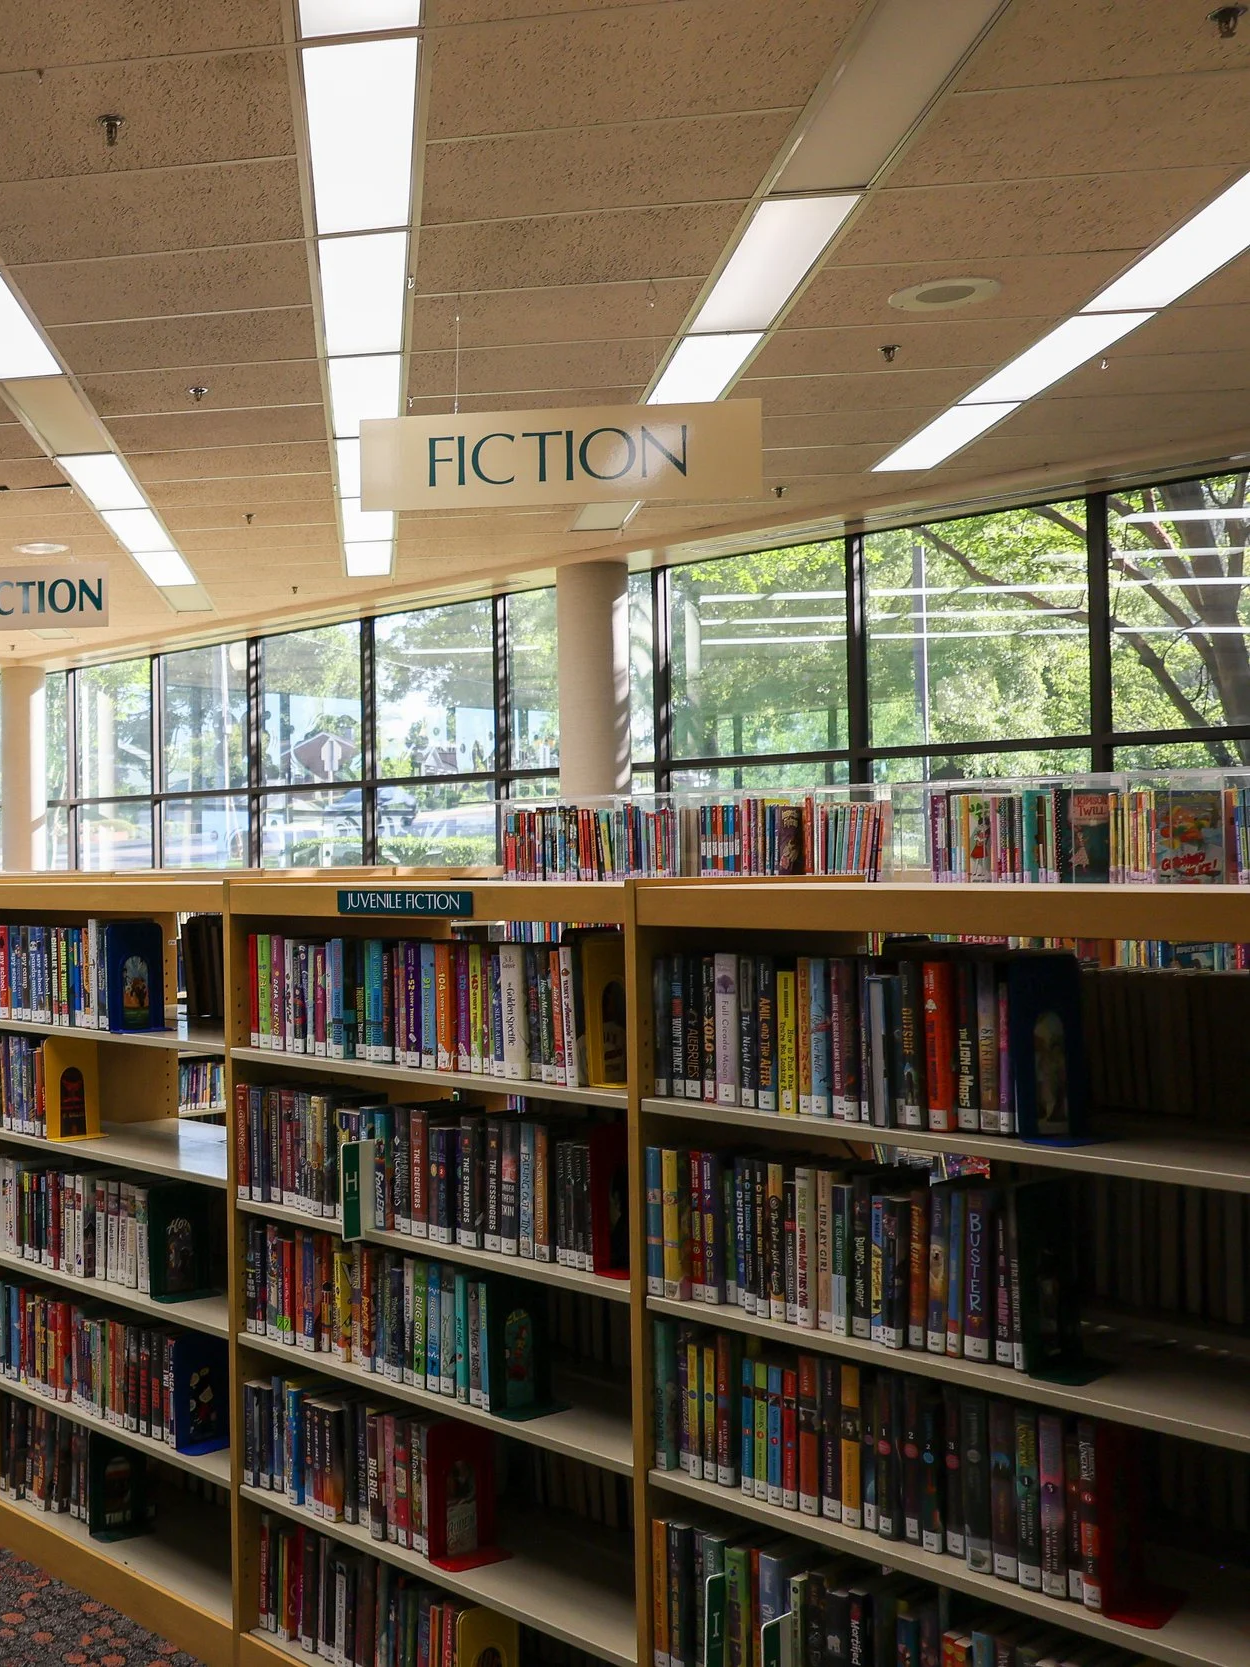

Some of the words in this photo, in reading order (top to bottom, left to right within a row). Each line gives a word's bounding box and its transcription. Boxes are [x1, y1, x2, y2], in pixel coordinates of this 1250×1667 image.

[428, 425, 687, 487] FICTION
[347, 893, 402, 910] JUVENILE
[405, 893, 460, 910] FICTION
[506, 988, 514, 1015] Golden
[722, 1000, 730, 1015] Full
[760, 997, 771, 1021] AMIL
[494, 1007, 502, 1031] SILVER
[506, 1017, 516, 1046] Specific
[672, 1018, 682, 1044] WON'T
[742, 1015, 751, 1030] The
[494, 1032, 502, 1056] ARROW
[704, 1016, 715, 1052] XOLO
[722, 1019, 730, 1050] Cicada
[814, 1037, 823, 1052] Over
[672, 1046, 682, 1073] DANCE
[687, 1028, 699, 1077] ALEBRIJES
[742, 1036, 751, 1062] Night
[959, 1041, 972, 1065] LION
[981, 1029, 995, 1092] SKYRIDERS
[722, 1054, 730, 1079] Moon
[761, 1058, 772, 1086] AFTER
[814, 1053, 823, 1073] Water
[742, 1066, 751, 1089] Diar
[959, 1075, 974, 1108] MARS
[489, 1159, 497, 1175] THE
[521, 1153, 530, 1189] FALLING
[346, 1171, 357, 1192] H
[375, 1171, 385, 1211] FOOLED
[489, 1177, 497, 1230] MESSENGERS
[521, 1191, 530, 1209] OUT
[521, 1217, 530, 1240] TIME
[835, 1214, 844, 1228] PINE
[835, 1228, 844, 1249] ISLAND
[855, 1236, 865, 1265] BUMPS
[835, 1249, 844, 1275] VISITORS
[969, 1213, 983, 1312] BUSTER
[799, 1272, 808, 1289] THIS
[799, 1291, 809, 1308] ONE
[855, 1279, 864, 1308] NIGHT
[415, 1296, 423, 1318] BUG
[415, 1322, 423, 1346] GIRL
[456, 1317, 464, 1329] girl
[152, 1378, 160, 1409] REFUGEE
[656, 1388, 664, 1441] OVERBOARD
[369, 1457, 378, 1477] BIG
[411, 1438, 420, 1481] EVENTOWN
[1079, 1441, 1091, 1481] KINGDOM
[369, 1479, 378, 1499] RIG
